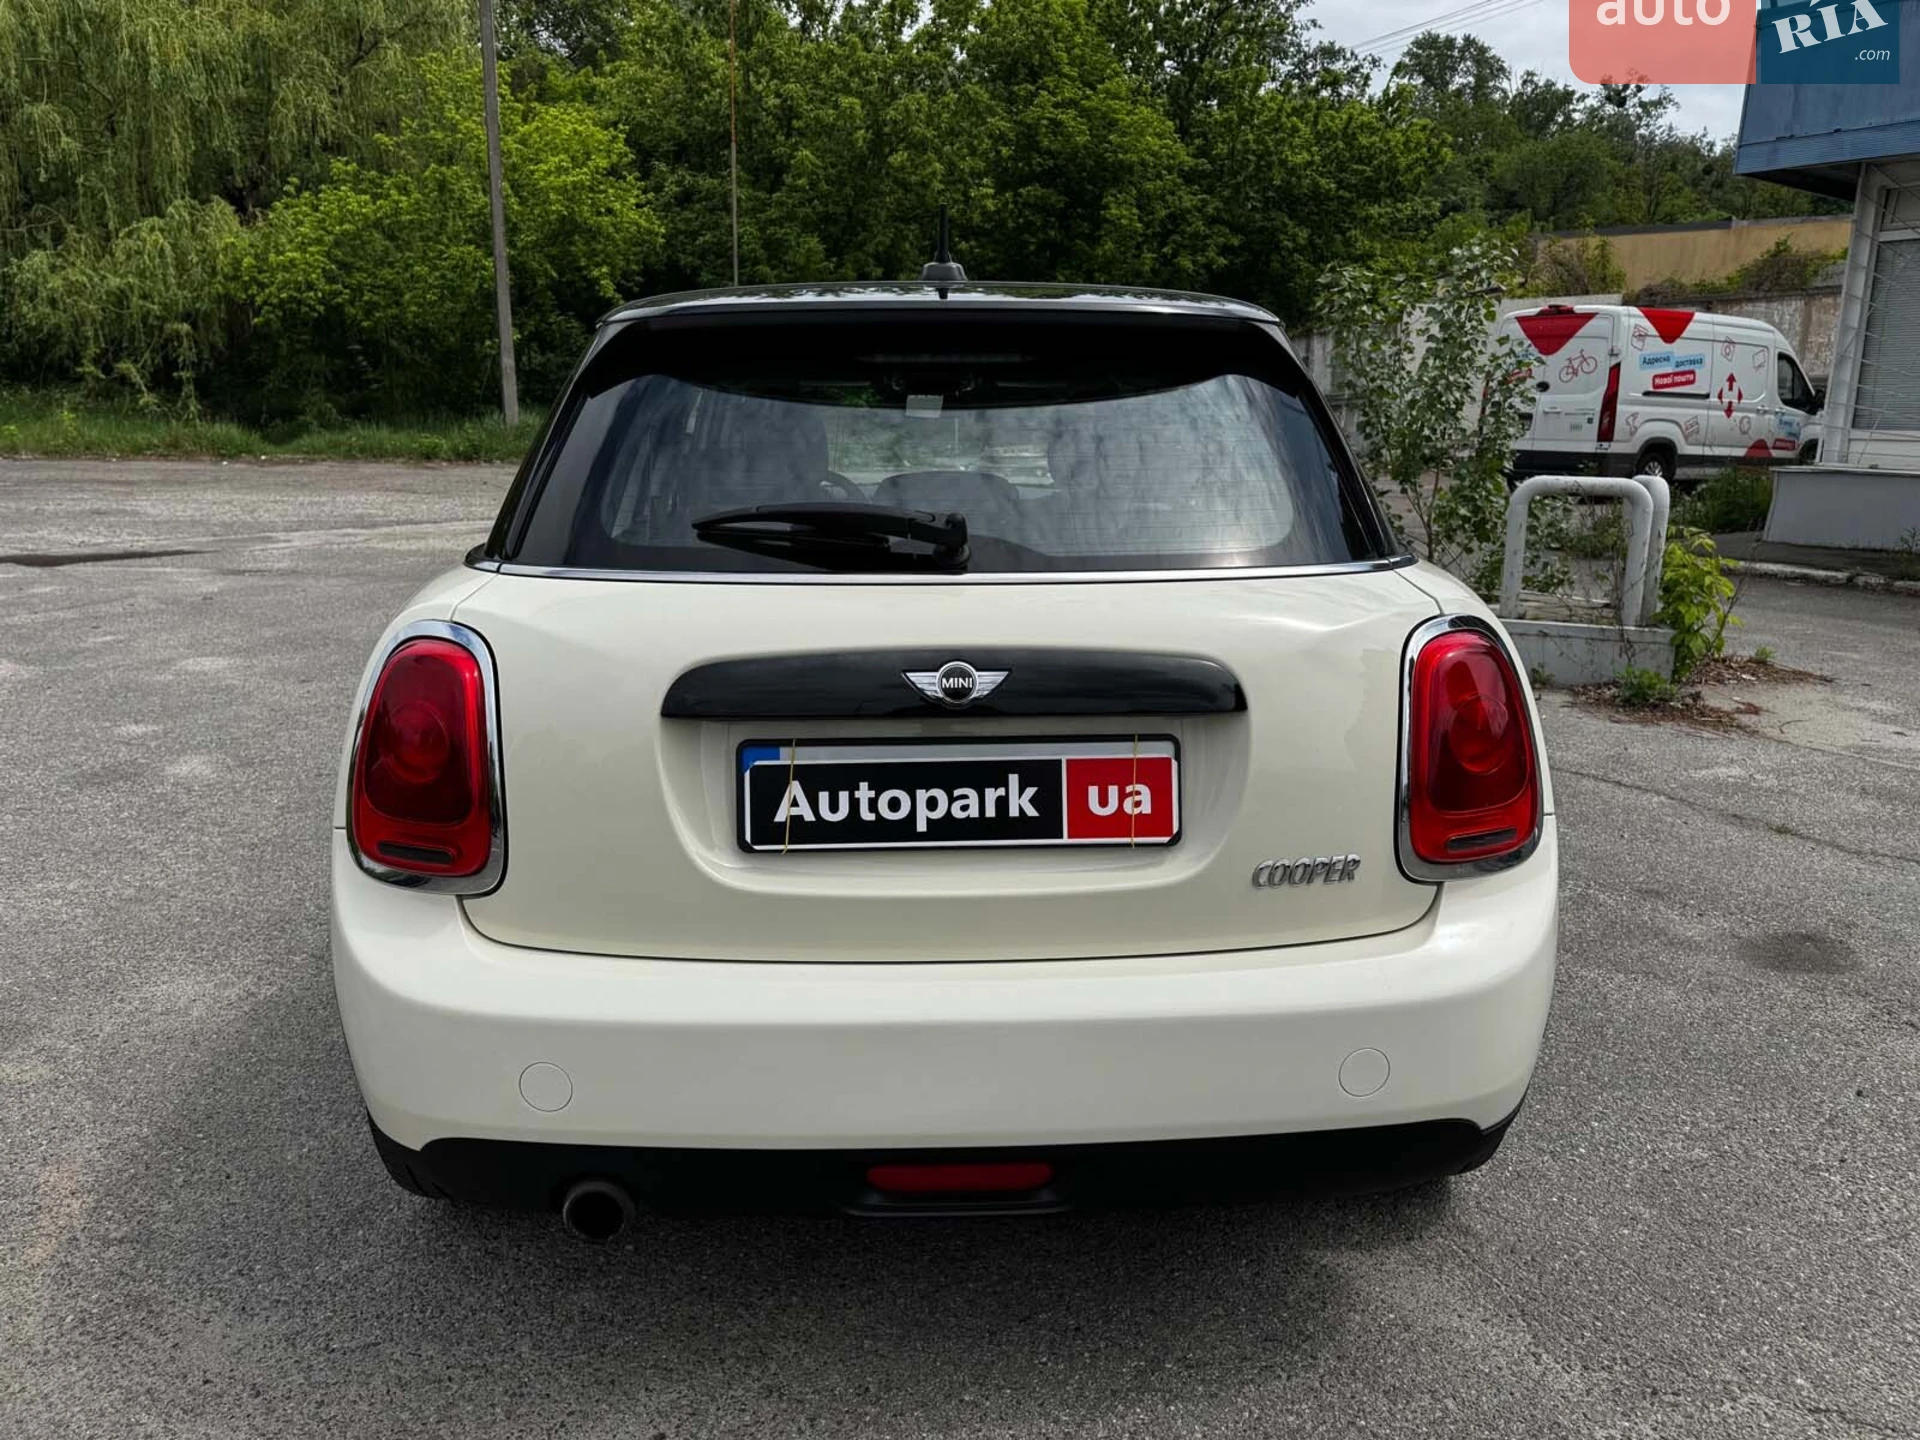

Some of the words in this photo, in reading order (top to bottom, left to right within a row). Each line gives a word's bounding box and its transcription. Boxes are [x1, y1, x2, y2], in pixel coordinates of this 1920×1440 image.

[941, 677, 973, 689] MINI
[773, 773, 1040, 833] Autopark
[1087, 782, 1152, 816] ua
[1252, 853, 1361, 889] COOPER
